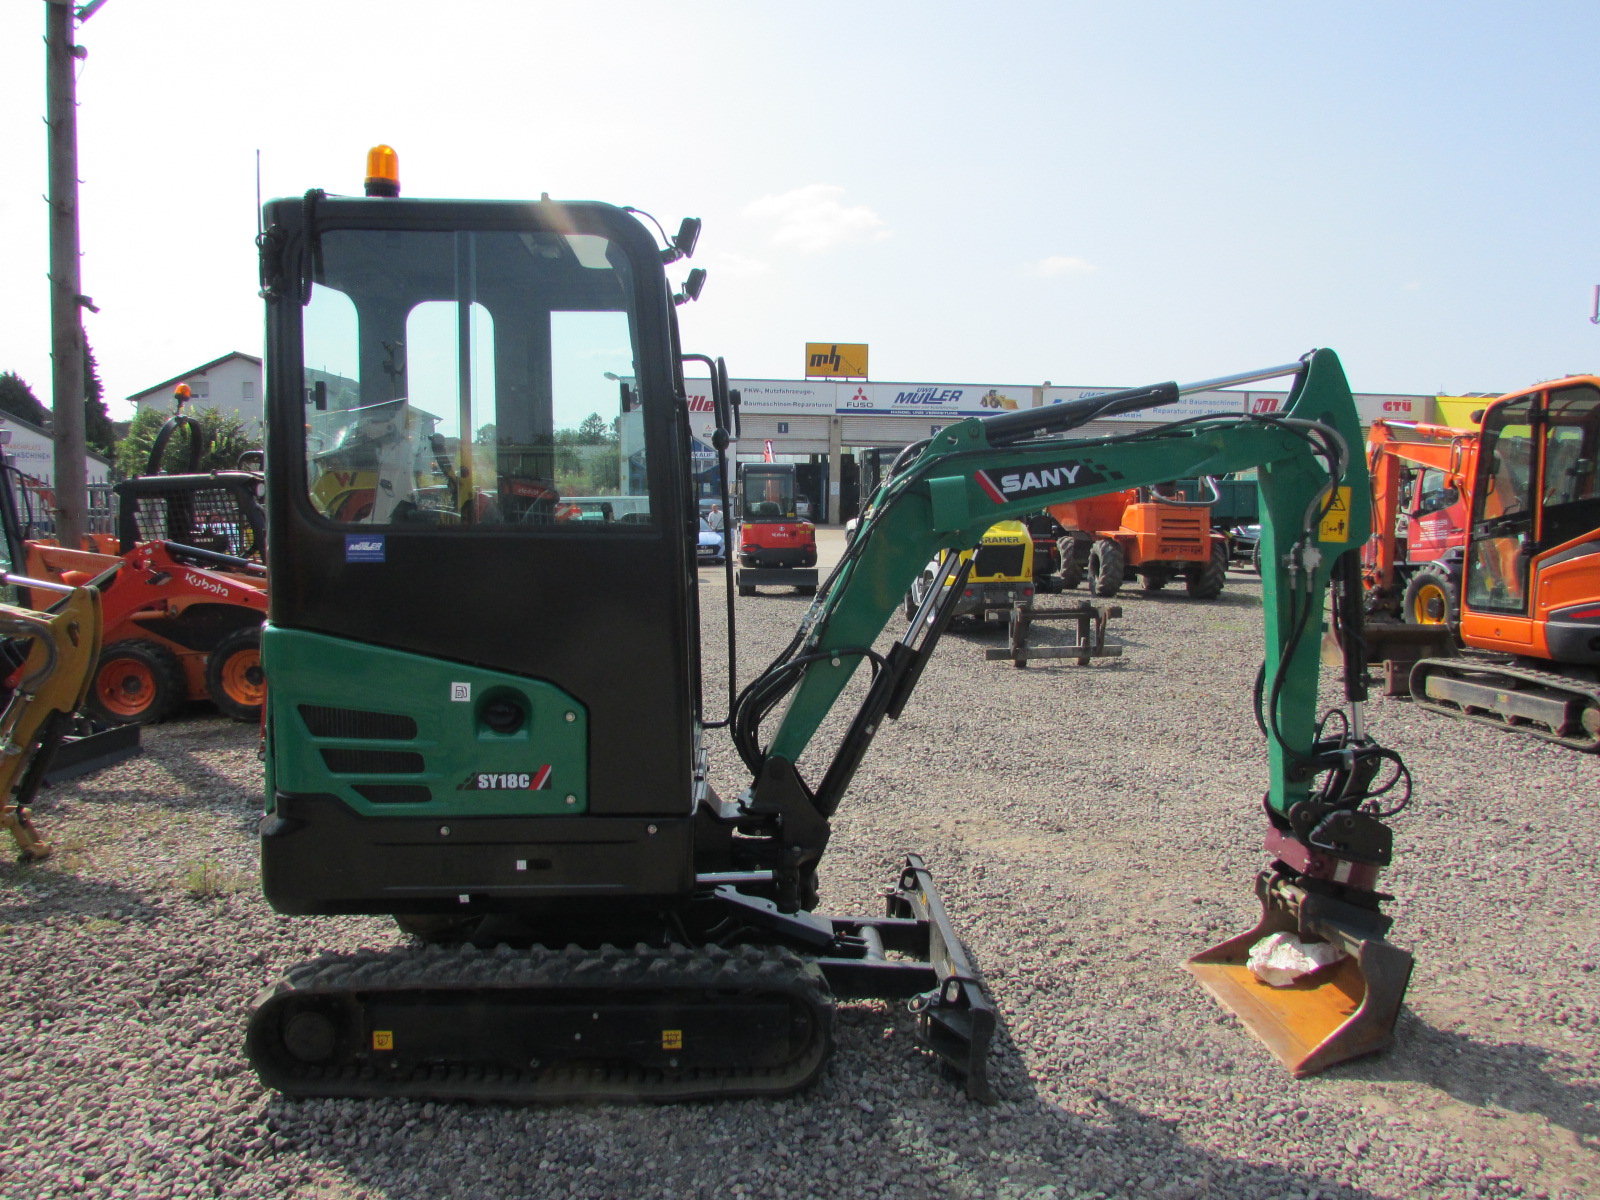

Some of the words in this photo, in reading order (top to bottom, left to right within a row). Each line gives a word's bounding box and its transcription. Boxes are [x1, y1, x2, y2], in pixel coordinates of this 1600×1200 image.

[893, 387, 963, 405] MÜLLER
[743, 400, 833, 408] Baumaschinen-Reparaturen
[1188, 399, 1242, 407] Baumaschinen-
[1382, 400, 1412, 412] GTÜ
[1152, 407, 1189, 415] Reparatur
[1001, 464, 1081, 494] SANY
[184, 571, 230, 598] Kubota
[478, 774, 530, 789] SY18C
